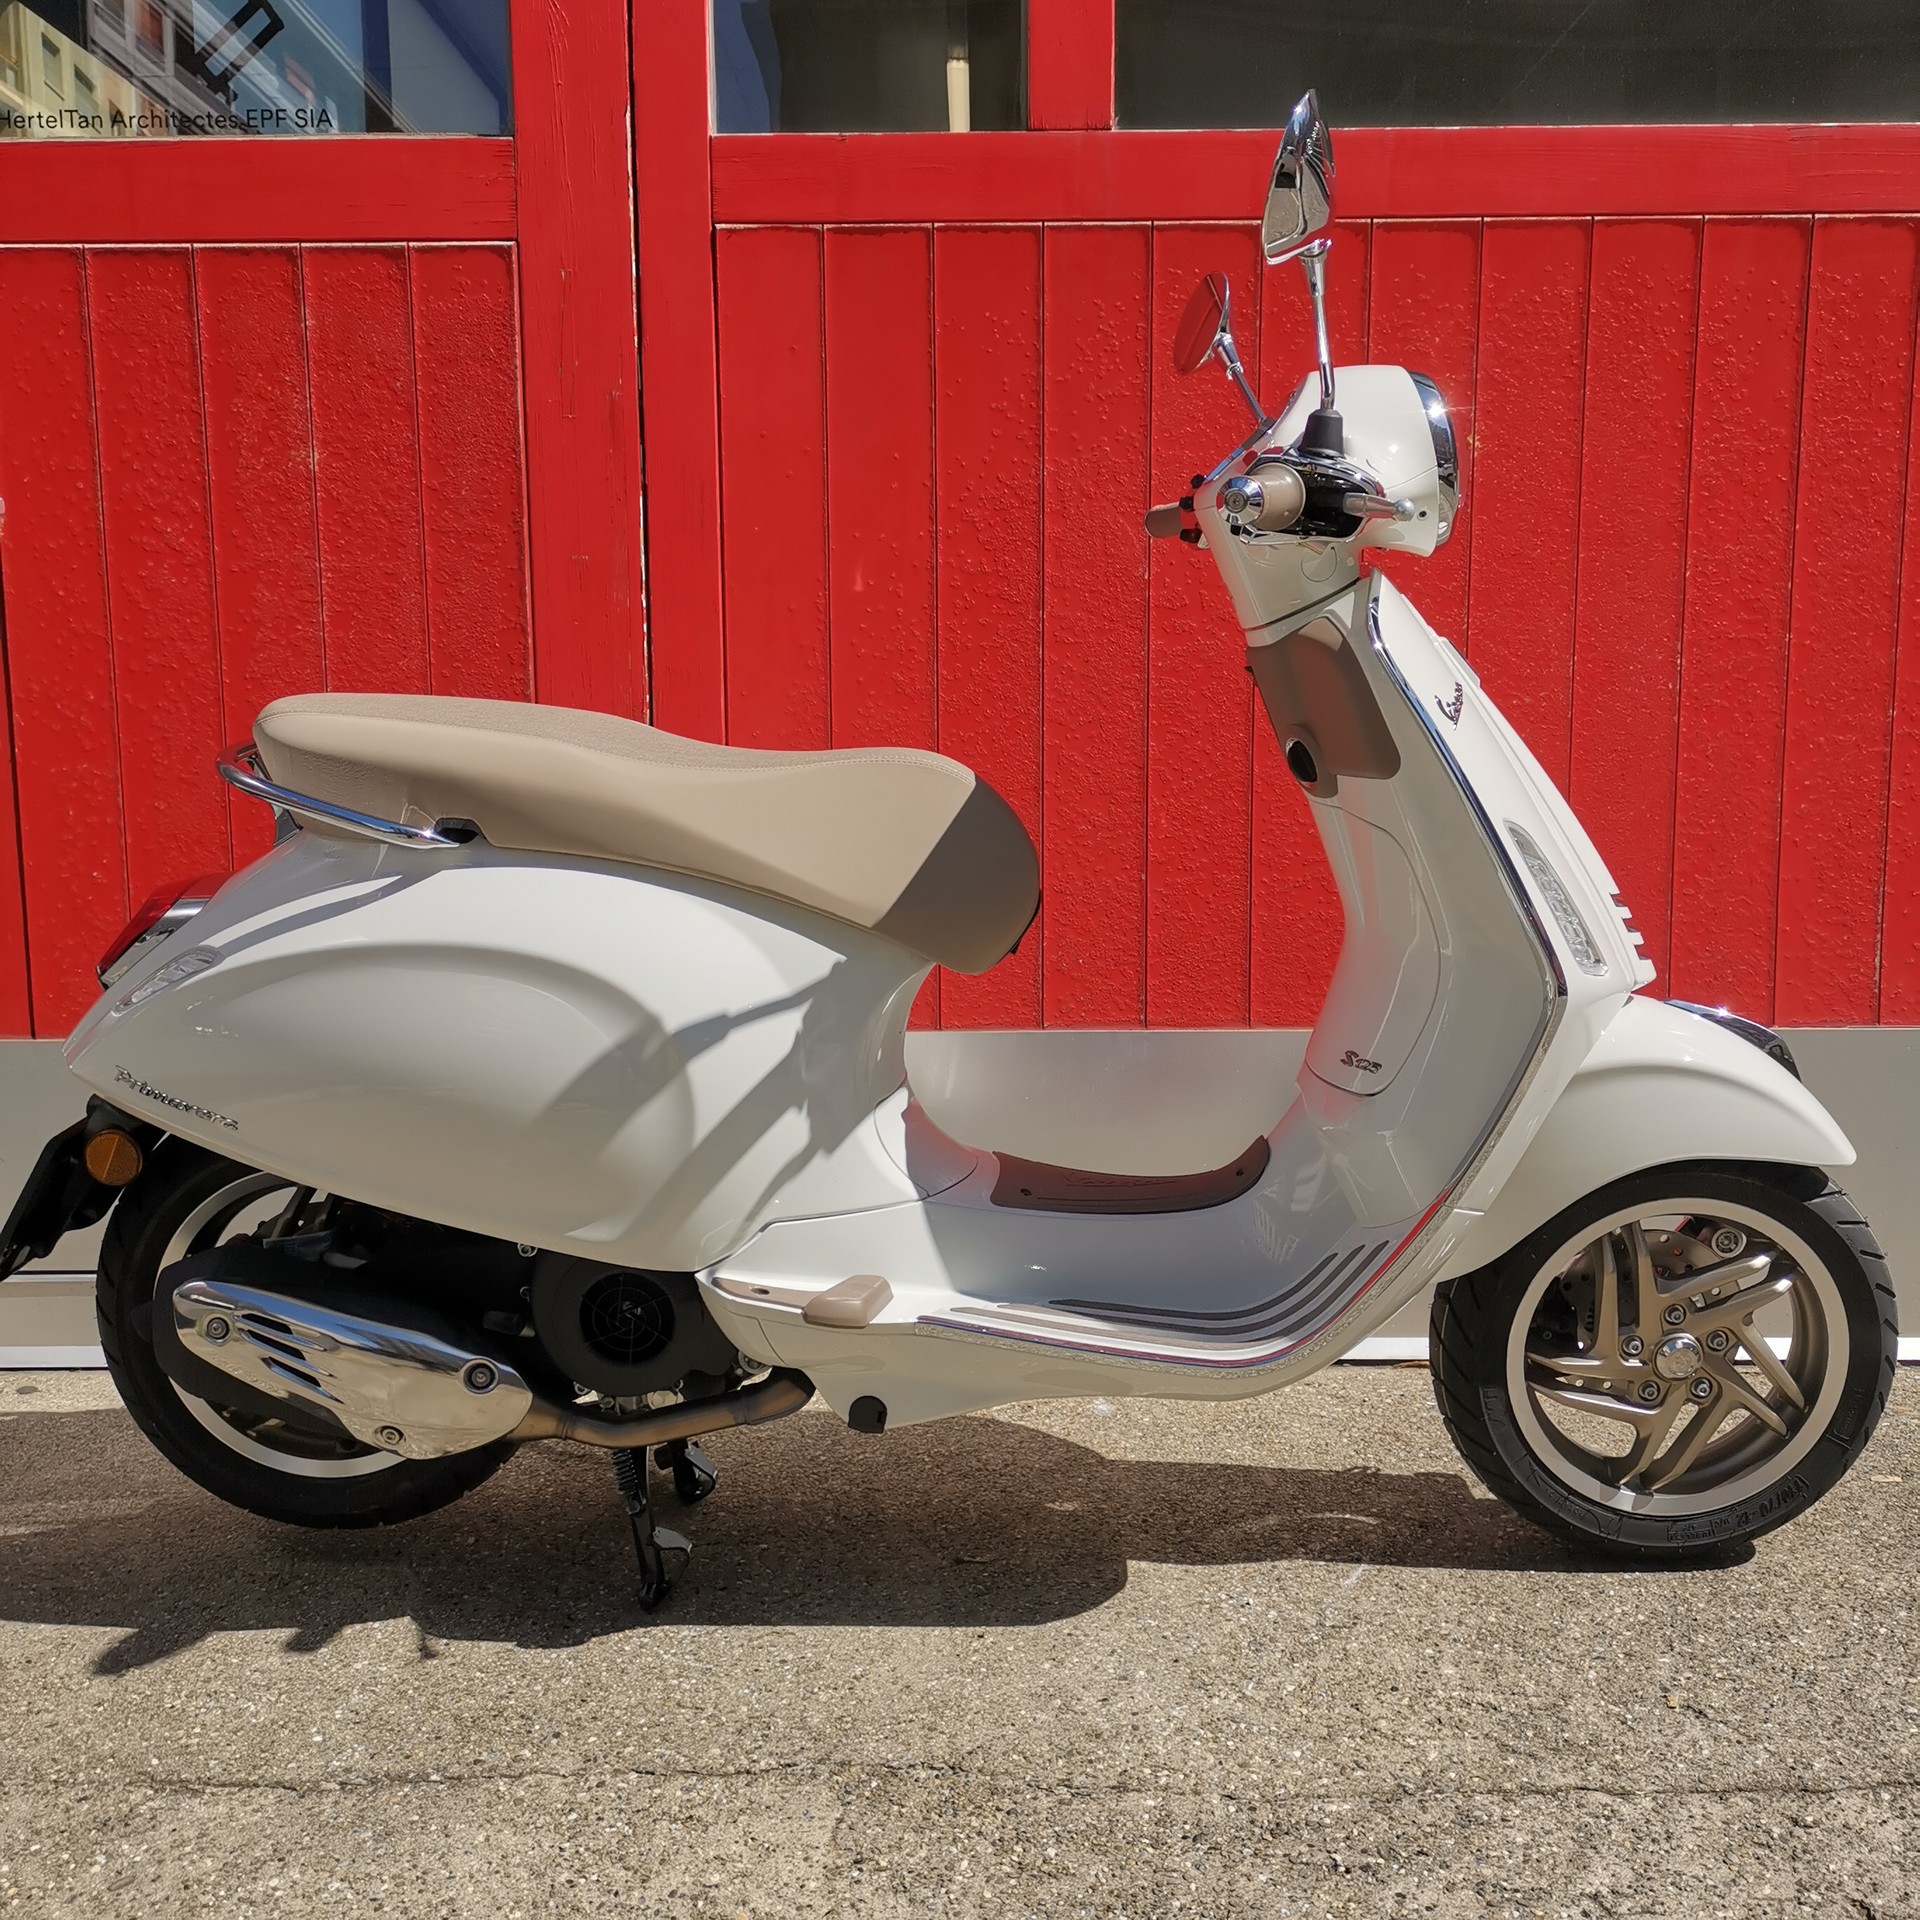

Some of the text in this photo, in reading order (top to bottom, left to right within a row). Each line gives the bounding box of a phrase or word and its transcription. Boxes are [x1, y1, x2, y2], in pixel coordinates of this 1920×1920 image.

[111, 108, 238, 129] Architectes
[246, 109, 287, 128] EPF
[294, 108, 333, 128] SIA
